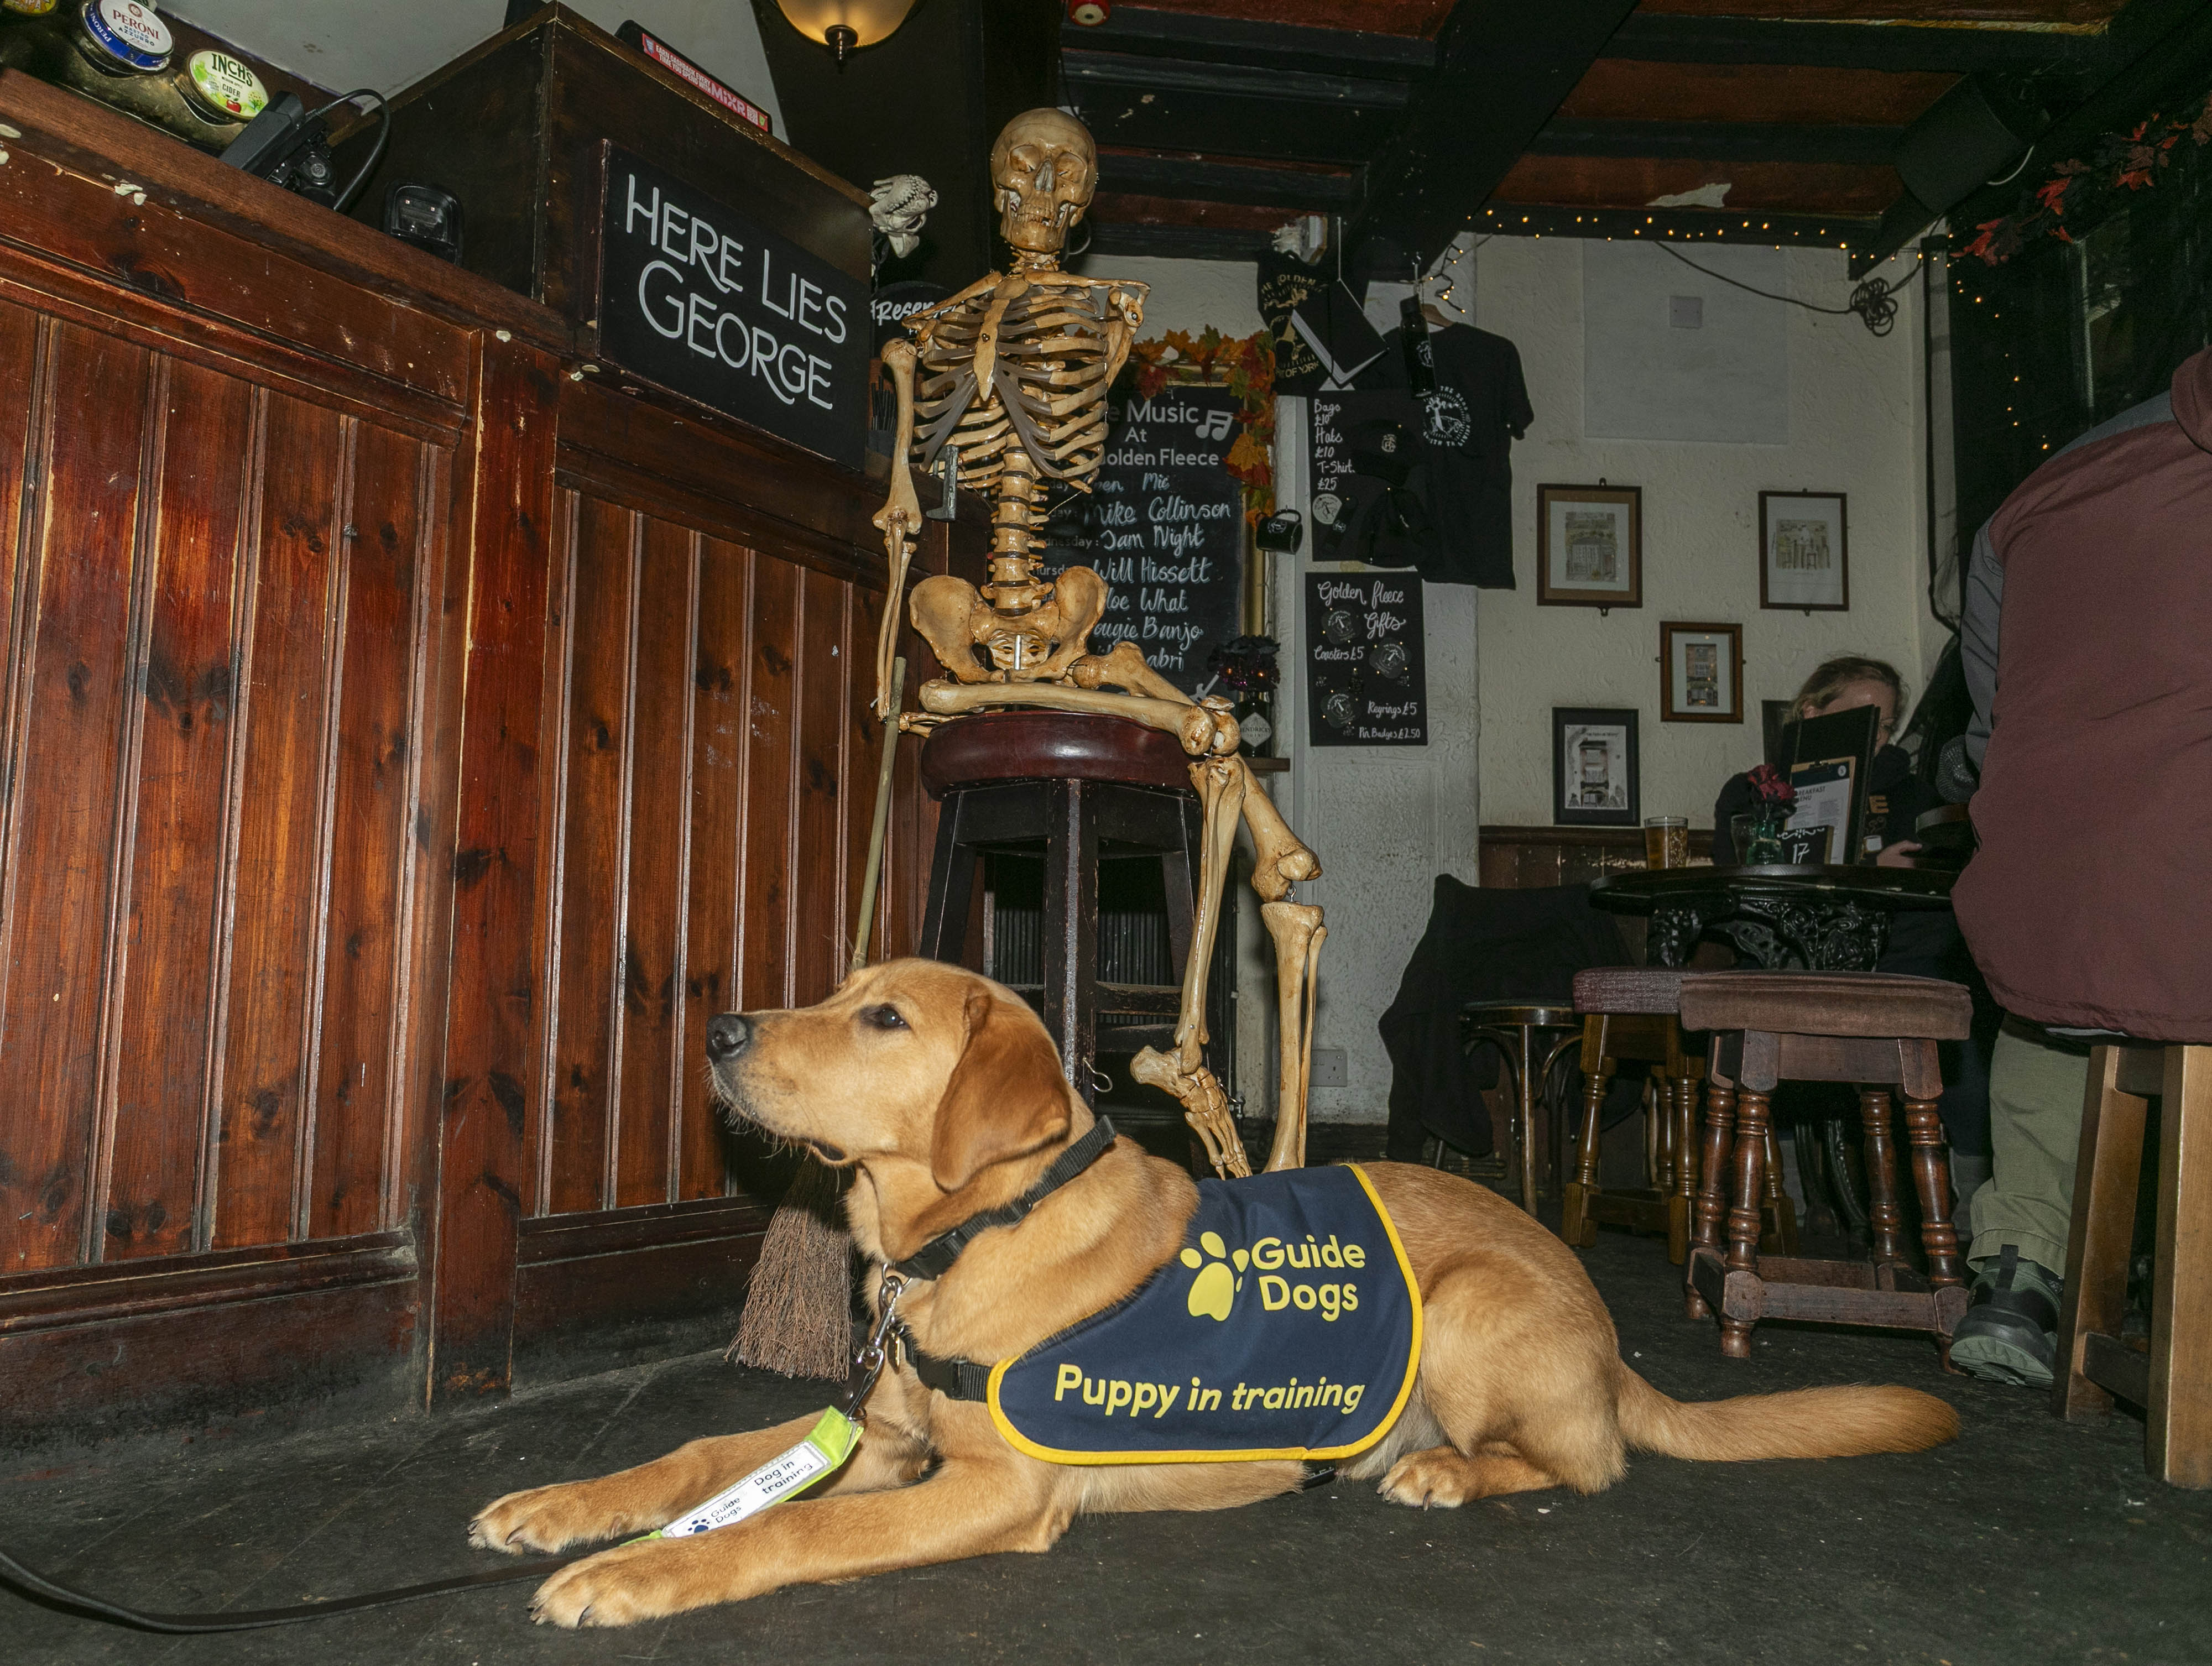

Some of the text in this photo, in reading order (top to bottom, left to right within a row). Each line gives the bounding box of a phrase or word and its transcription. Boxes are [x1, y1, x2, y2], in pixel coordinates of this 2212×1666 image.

[113, 9, 159, 40] PERONI
[124, 25, 149, 39] NASTRO
[118, 27, 155, 46] AZZURRO
[656, 45, 670, 59] EARN
[211, 53, 253, 87] INCH'S
[660, 54, 672, 67] TIME
[672, 62, 682, 74] YOU
[222, 83, 240, 98] CIDER
[627, 174, 847, 343] HERE LIES
[639, 260, 833, 409] GEORGE
[1126, 400, 1199, 423] Music
[1314, 399, 1341, 416] Bags
[1314, 415, 1330, 426] £10
[1125, 426, 1147, 442] At
[1316, 427, 1343, 443] Hats
[1105, 448, 1219, 466] olden Fleece
[1315, 446, 1335, 458] £10
[1142, 472, 1170, 492] Mic
[1317, 477, 1338, 491] £25
[1147, 496, 1232, 524] Collinson
[1100, 530, 1144, 550] Jam
[1154, 523, 1205, 557] Night
[1141, 557, 1213, 583] Hissett
[1140, 587, 1189, 612] What
[1317, 581, 1367, 606] Golden
[1093, 616, 1204, 650] ougie Banjo
[1364, 612, 1406, 639] Gifts
[1314, 645, 1365, 661] Coasters £5
[1368, 701, 1402, 719] Keyrings
[1402, 702, 1418, 716] £5
[1359, 727, 1420, 740] Pin Badges £2.50
[1792, 843, 1810, 864] 17
[1251, 1234, 1366, 1271] Guide
[1259, 1275, 1359, 1322] Dogs
[1055, 1363, 1366, 1418] Puppy in training
[754, 1460, 795, 1486] Dog in
[761, 1463, 813, 1494] training
[711, 1496, 740, 1518] Guide
[716, 1506, 742, 1523] Dogs
